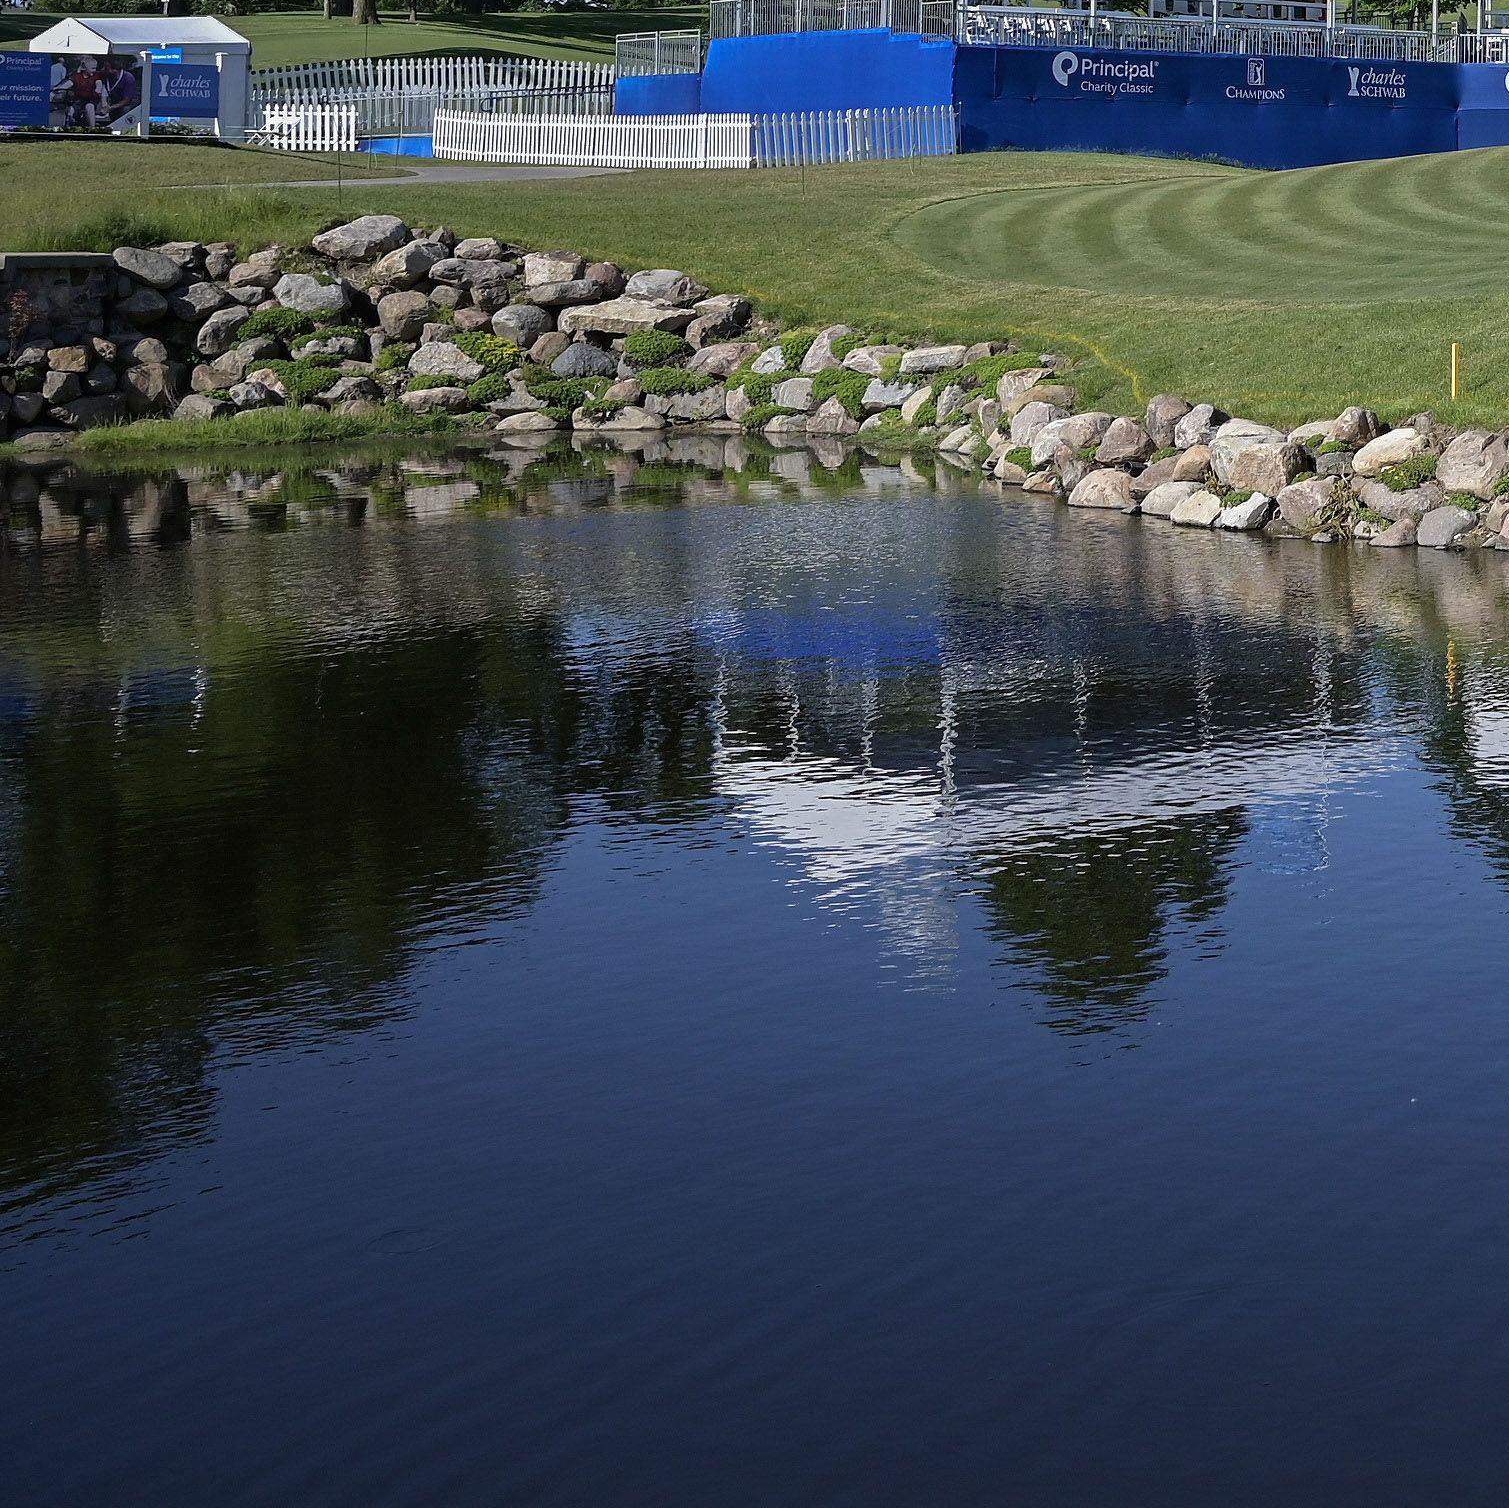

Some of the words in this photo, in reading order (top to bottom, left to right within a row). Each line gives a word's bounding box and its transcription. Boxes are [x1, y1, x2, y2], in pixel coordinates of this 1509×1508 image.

[170, 74, 212, 88] charles
[1361, 67, 1406, 85] charles
[169, 89, 211, 98] SCHWAB
[1080, 80, 1118, 95] Charity
[1119, 82, 1154, 94] Classic
[1225, 85, 1285, 100] CHAMPIONS
[1360, 86, 1406, 99] SCHWAB
